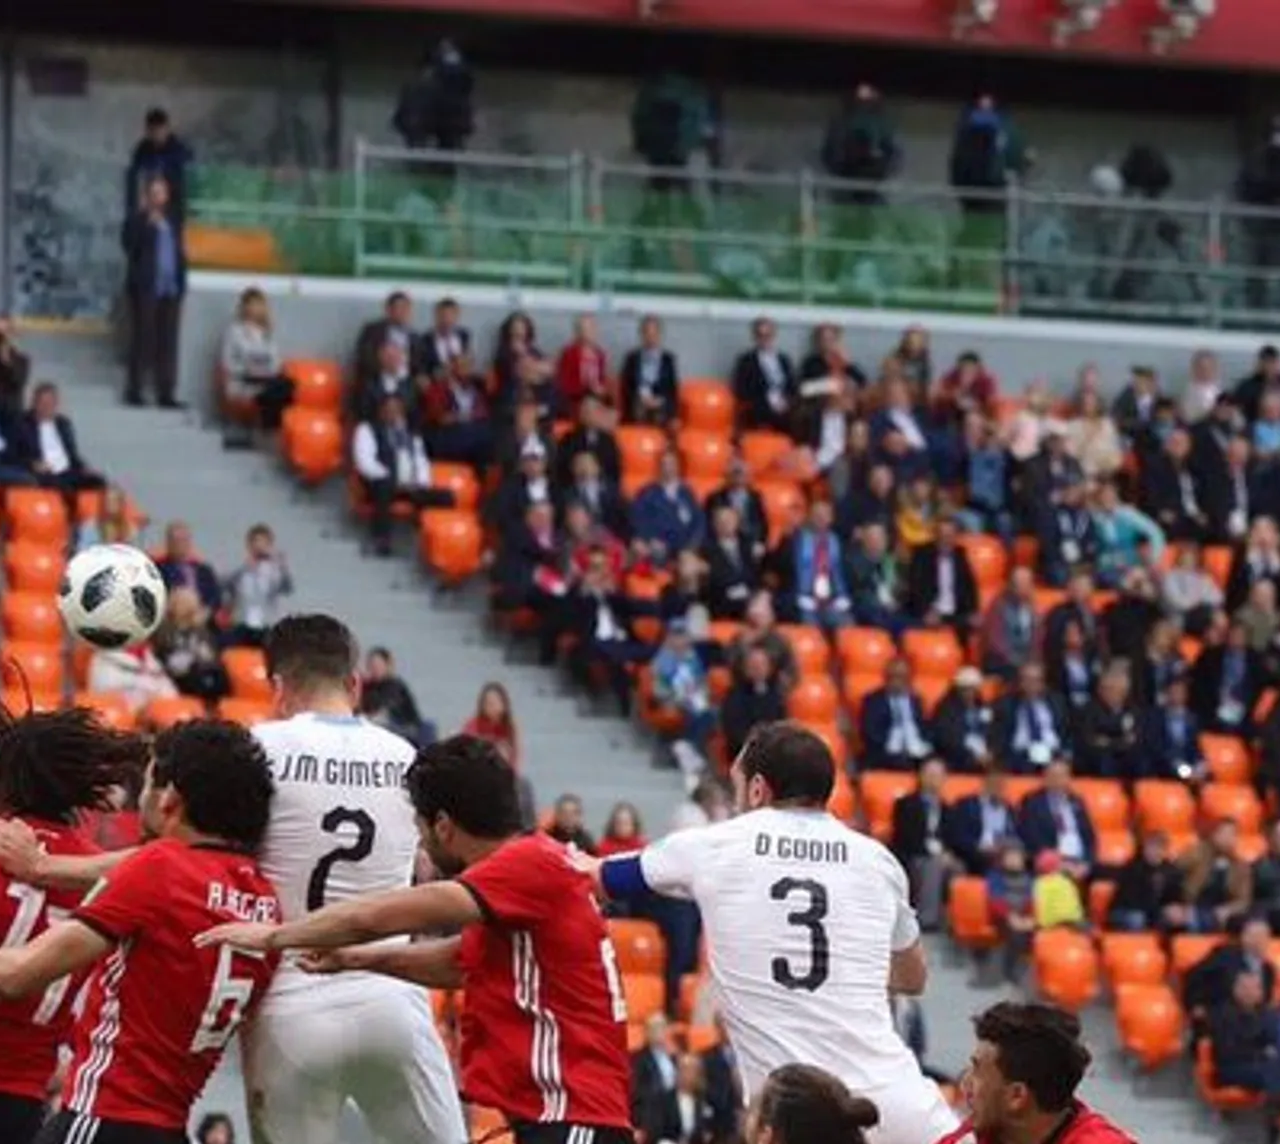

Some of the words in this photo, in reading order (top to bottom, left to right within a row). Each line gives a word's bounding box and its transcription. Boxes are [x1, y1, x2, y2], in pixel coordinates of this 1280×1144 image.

[306, 806, 376, 913] 2
[755, 832, 772, 856] D
[770, 876, 829, 992] 3
[190, 943, 266, 1052] 6
